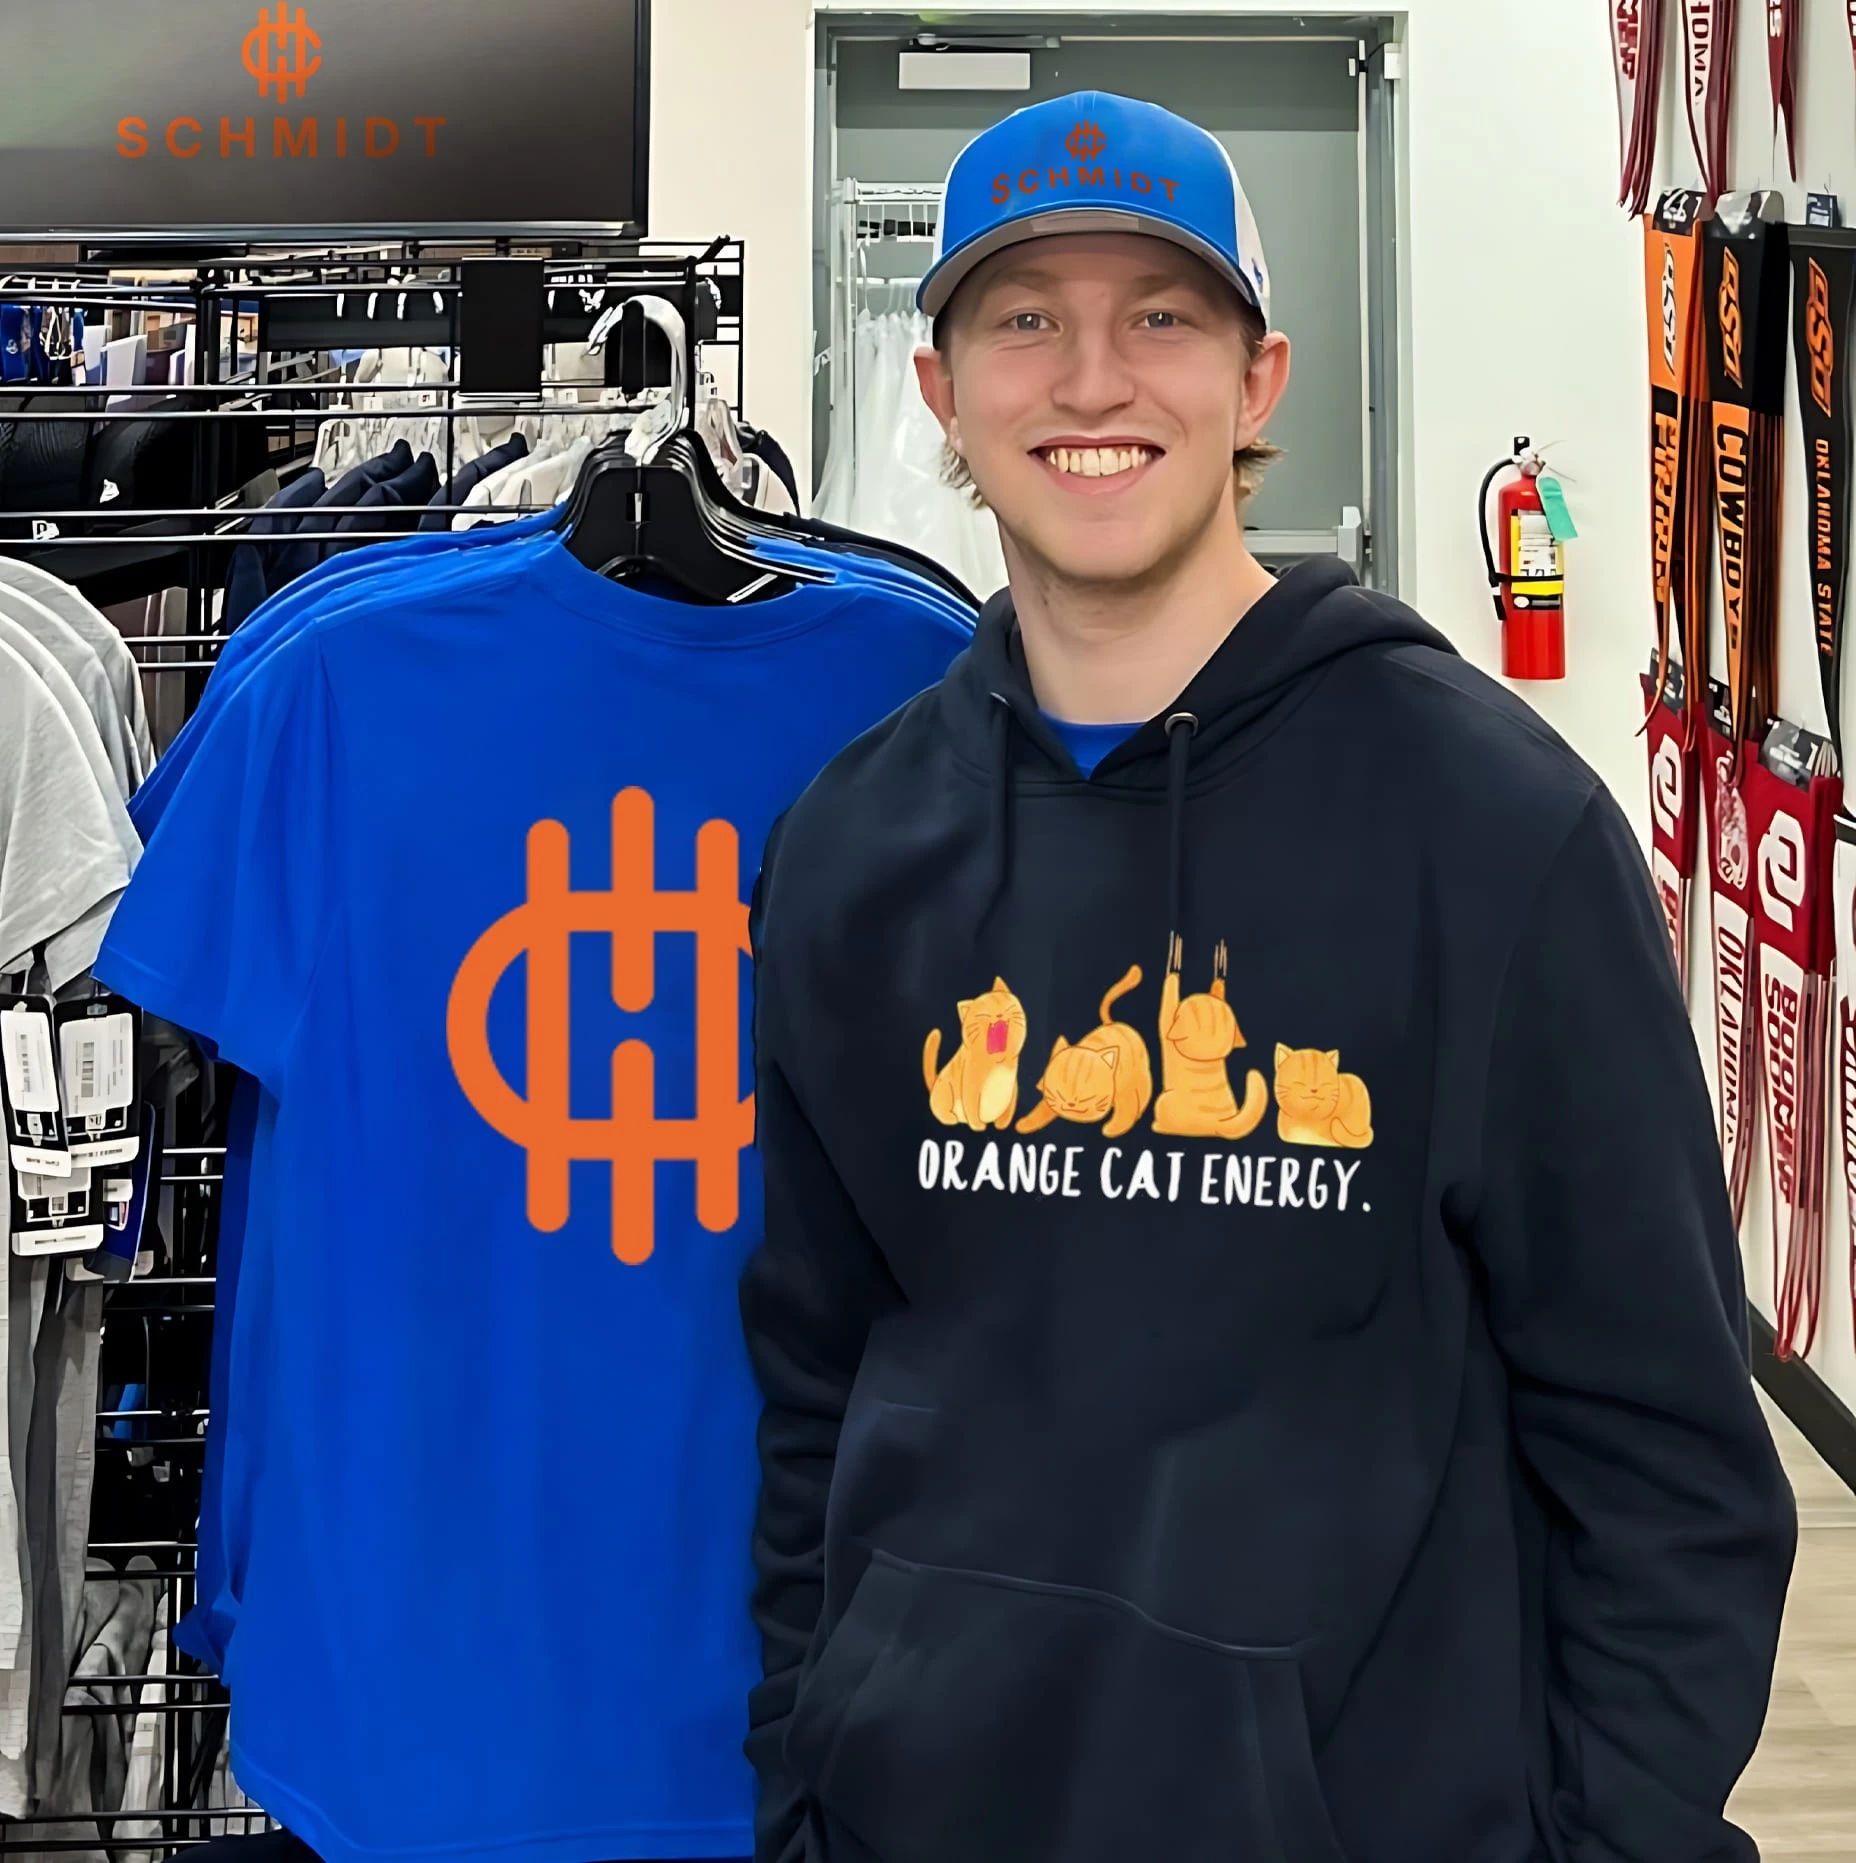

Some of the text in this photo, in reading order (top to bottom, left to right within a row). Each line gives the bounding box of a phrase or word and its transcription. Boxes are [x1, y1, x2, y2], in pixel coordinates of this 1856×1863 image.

[116, 116, 448, 159] SCHMIDT
[991, 165, 1181, 206] SCHMIDT
[1815, 438, 1833, 570] OKLAHOMA
[918, 1139, 1371, 1212] ORANGE CAT ENERGY.
